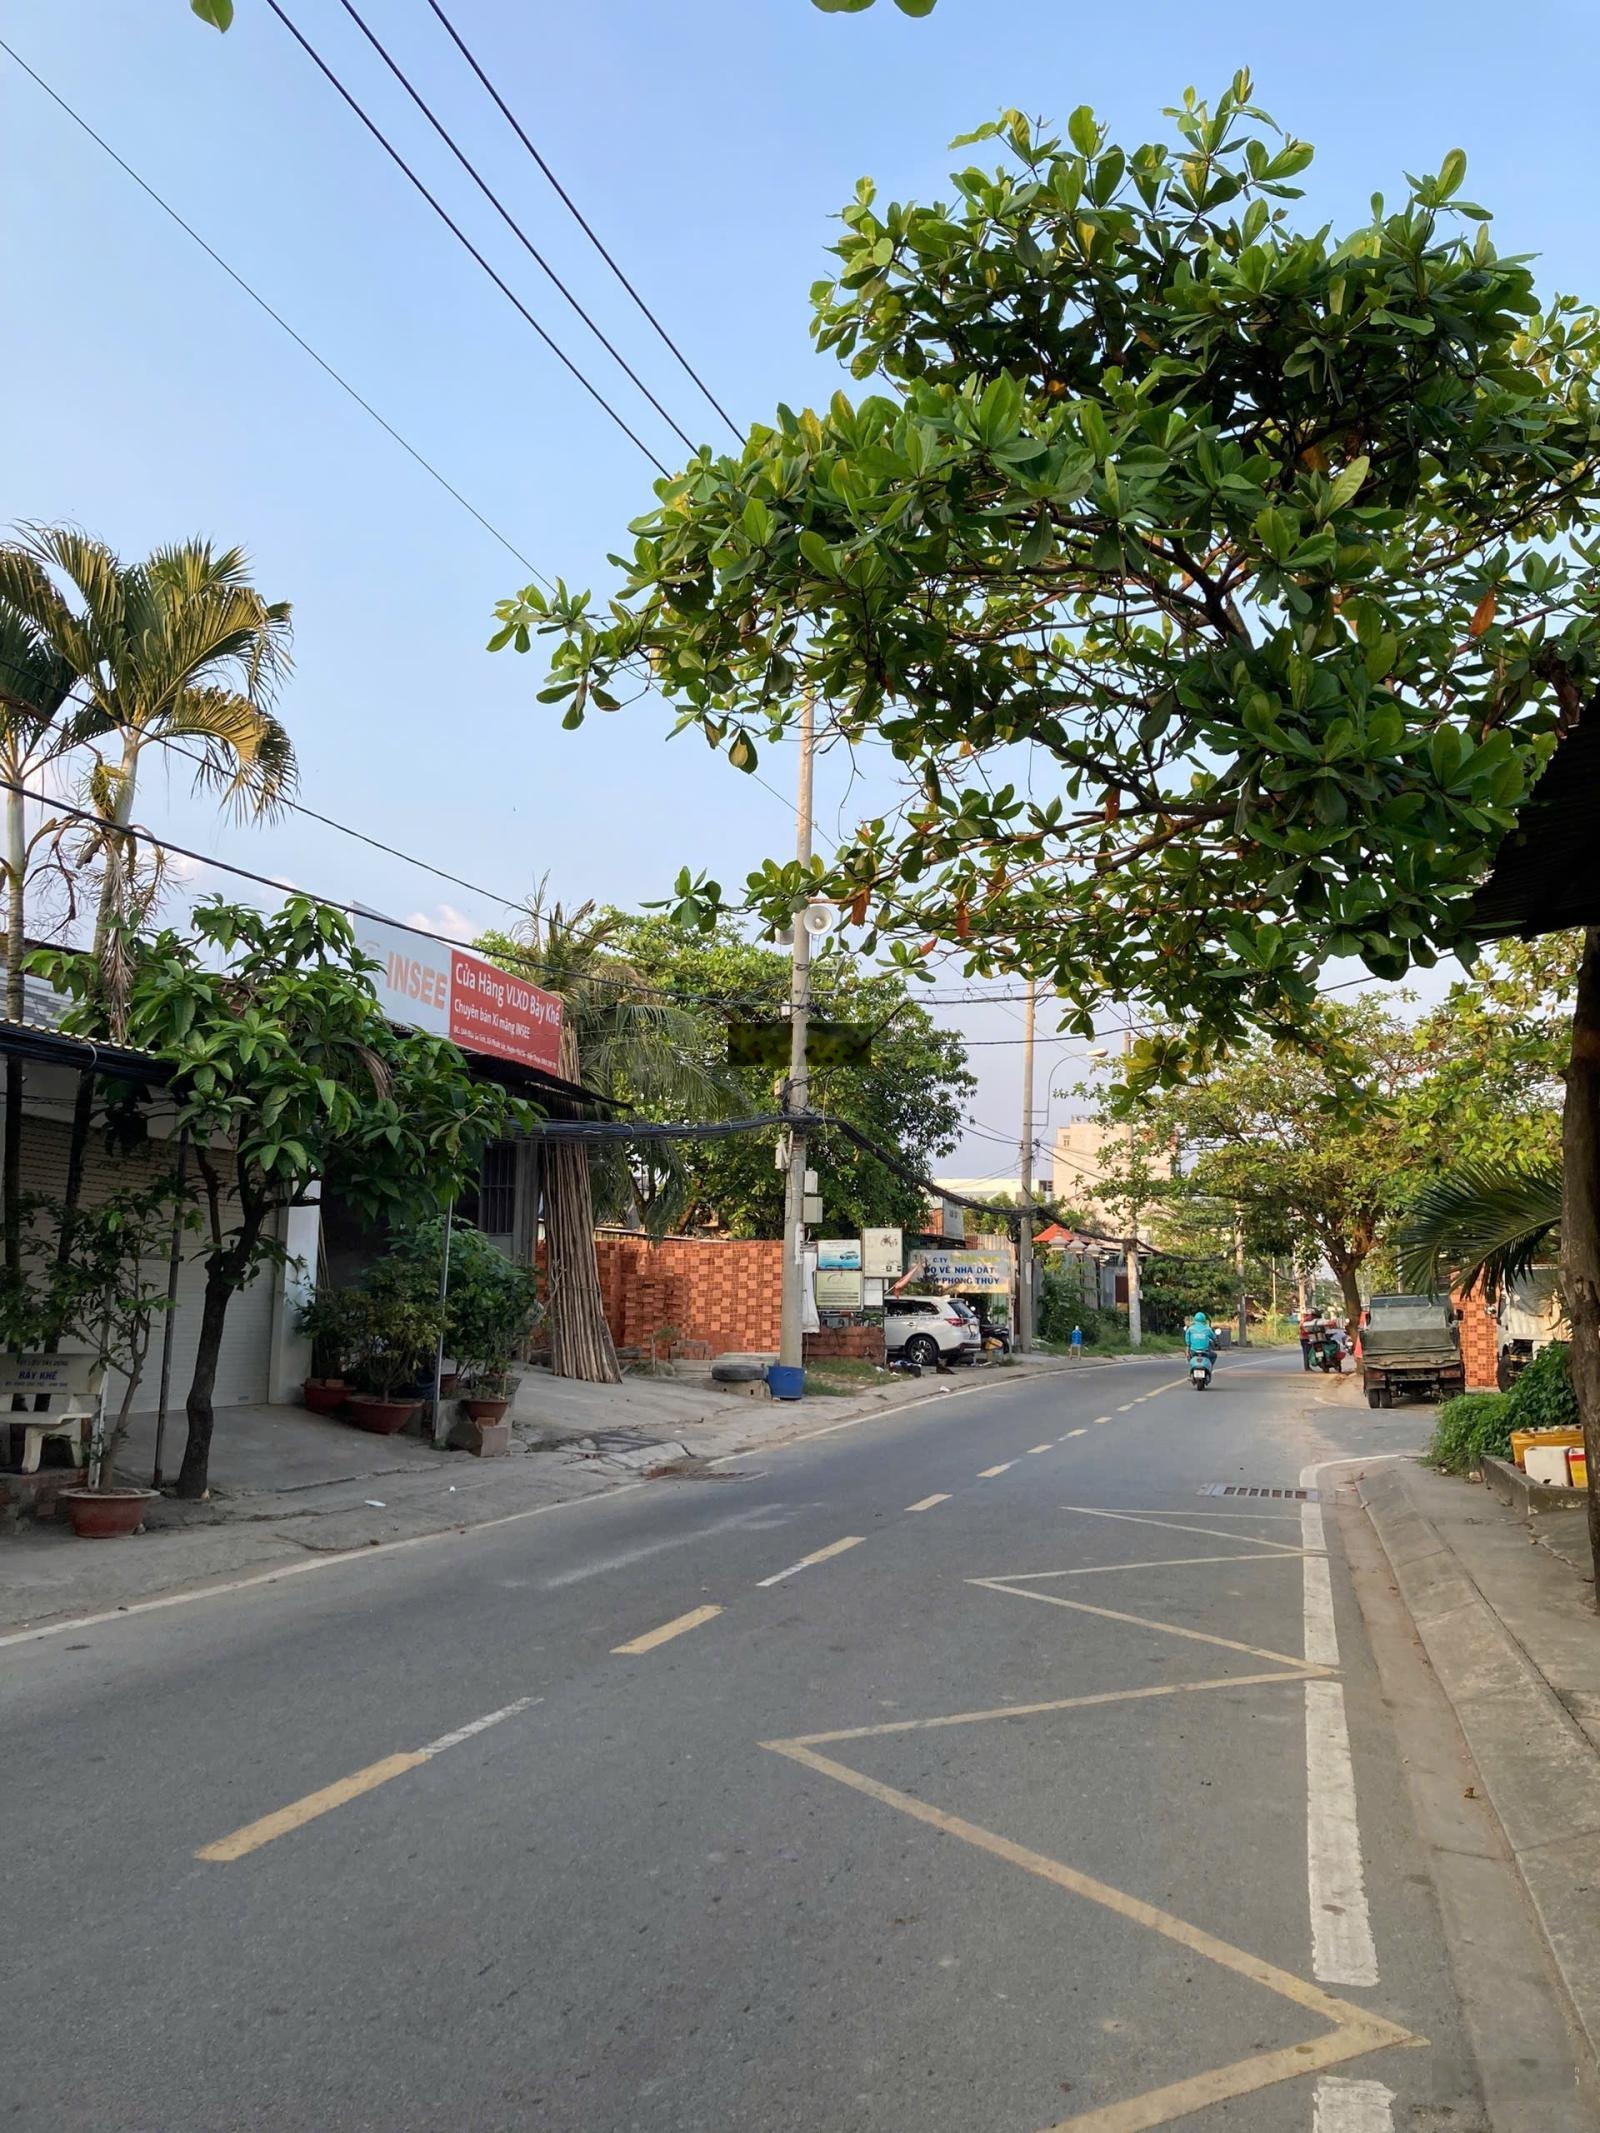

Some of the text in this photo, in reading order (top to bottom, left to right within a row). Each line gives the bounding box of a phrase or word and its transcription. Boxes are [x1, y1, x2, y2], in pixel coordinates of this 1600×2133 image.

[386, 951, 448, 1010] INSEE
[455, 963, 476, 990] Cửa
[478, 971, 505, 1008] Hàng
[506, 983, 529, 1011] VLXD
[515, 1022, 530, 1040] INSEE
